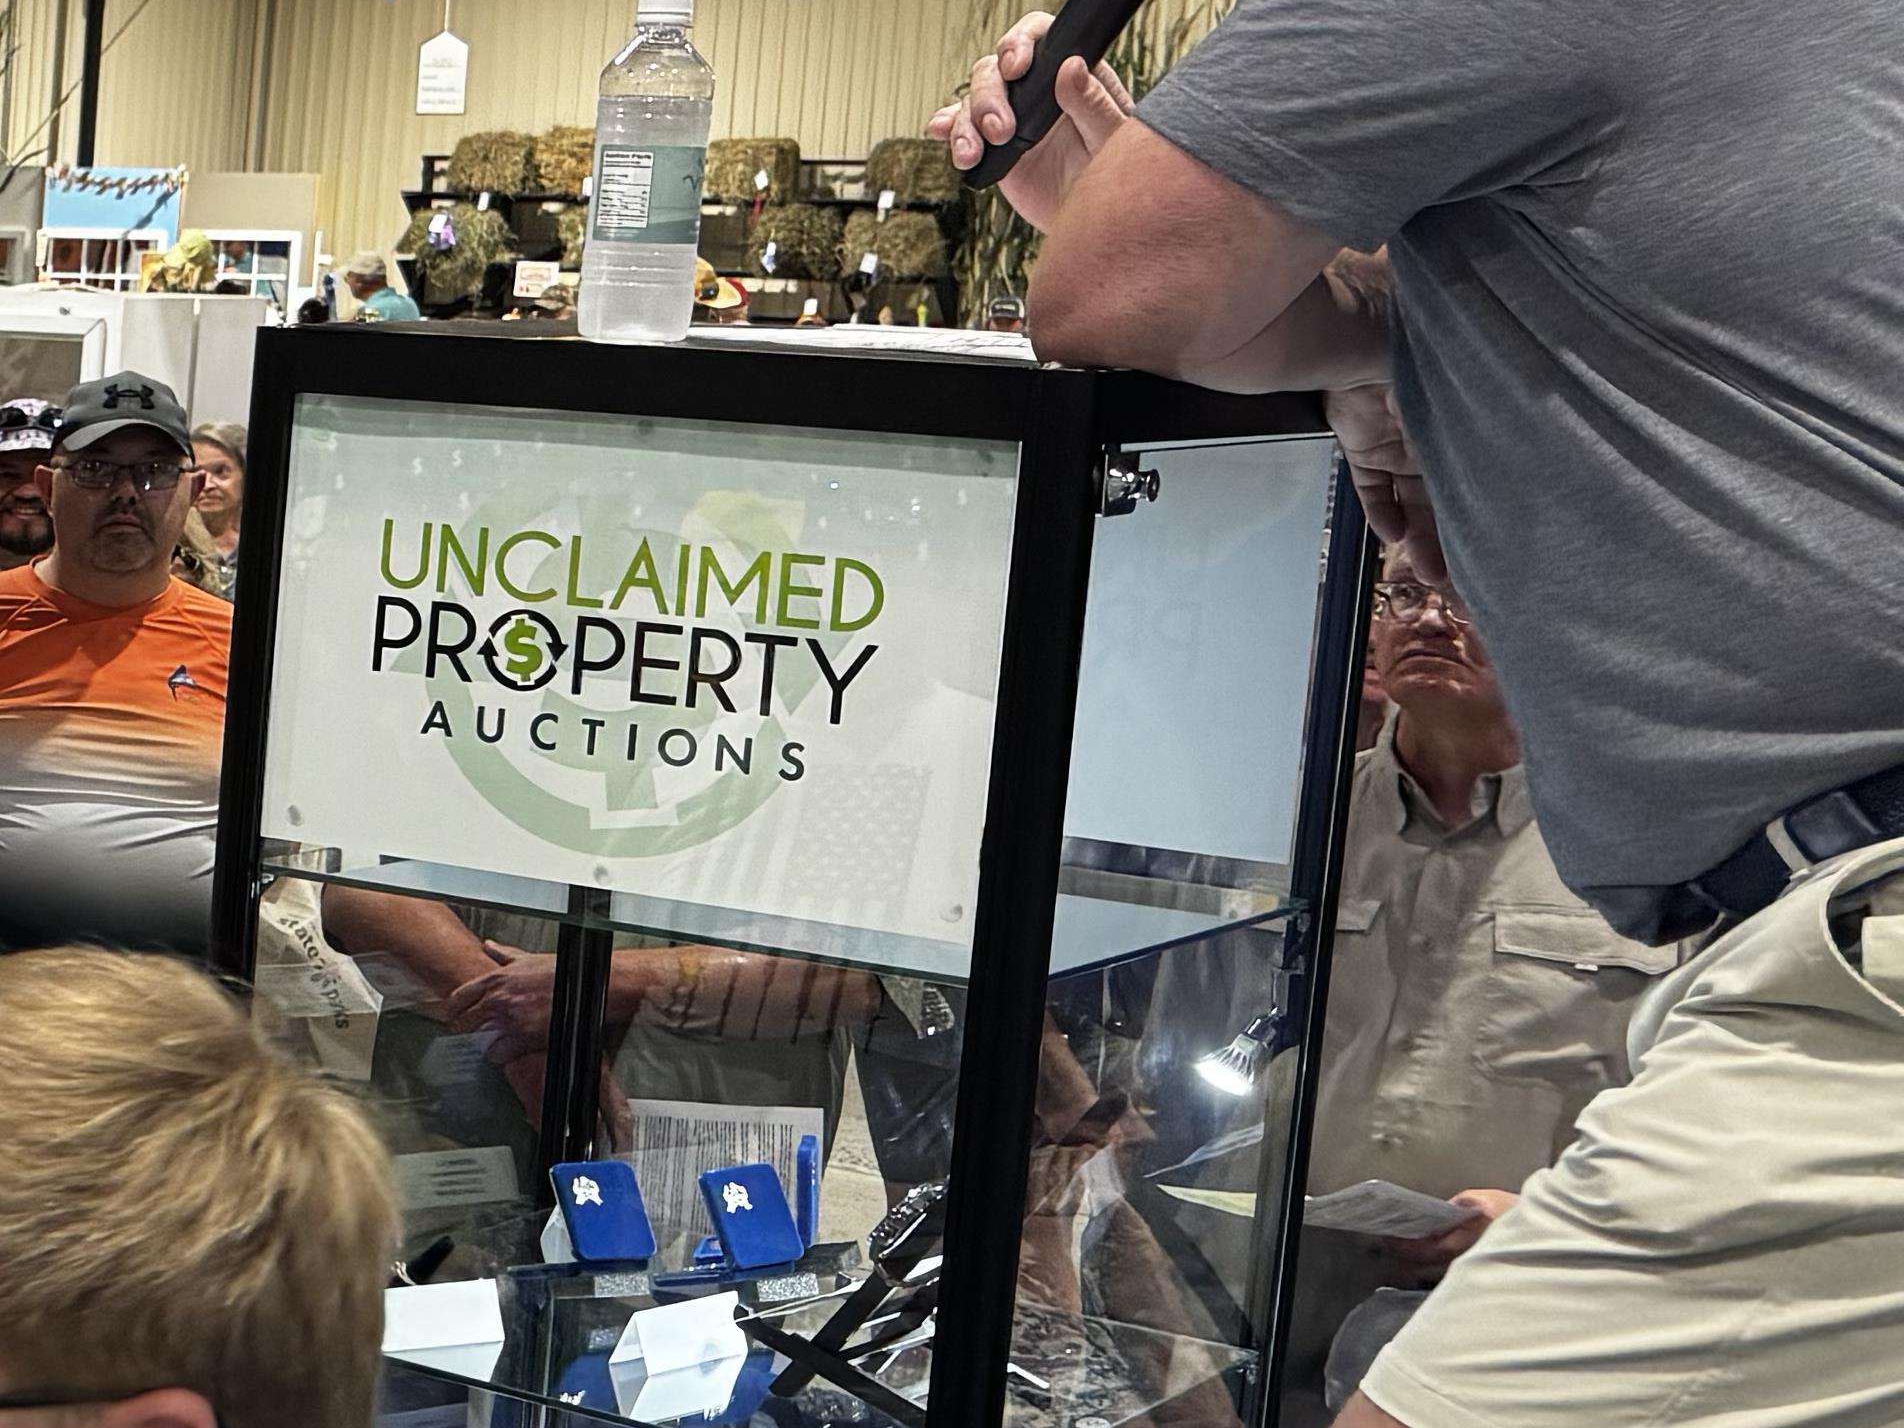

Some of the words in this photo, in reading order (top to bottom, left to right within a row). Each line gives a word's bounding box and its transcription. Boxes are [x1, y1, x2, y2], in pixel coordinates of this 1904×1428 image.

[379, 517, 886, 634] UNCLAIMED
[370, 594, 880, 726] PROPERTY
[420, 699, 806, 782] AUCTIONS
